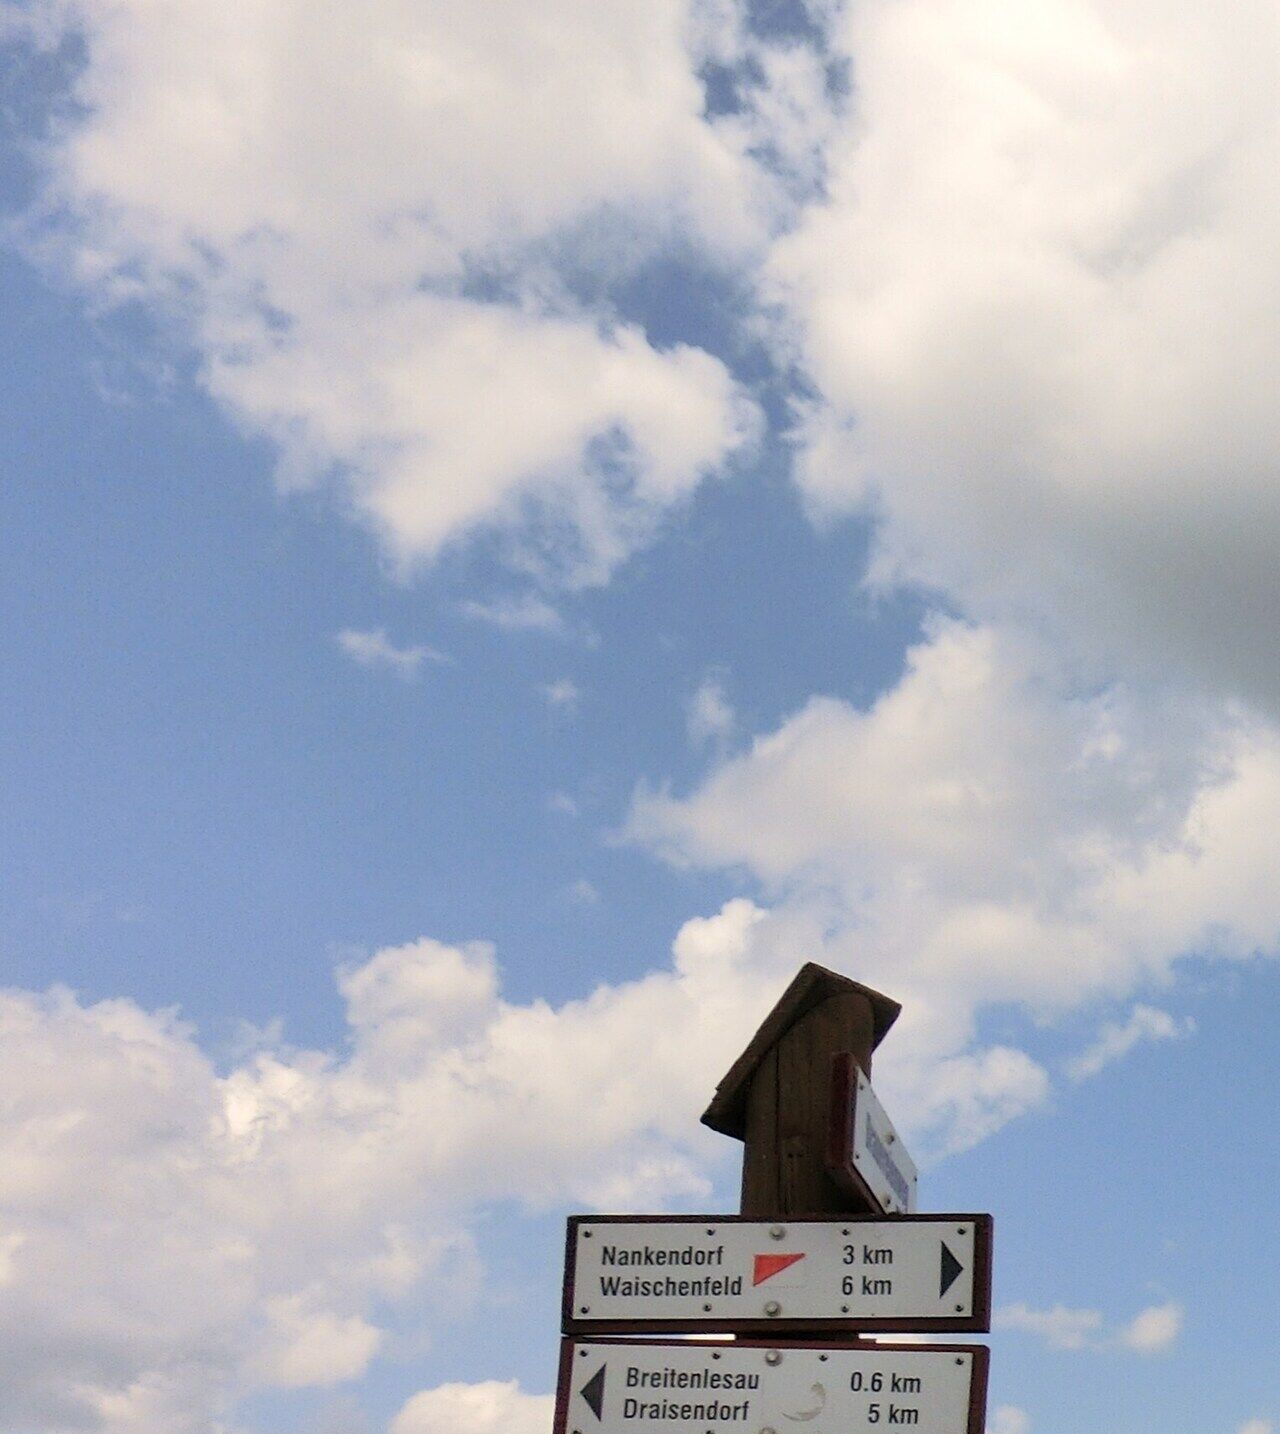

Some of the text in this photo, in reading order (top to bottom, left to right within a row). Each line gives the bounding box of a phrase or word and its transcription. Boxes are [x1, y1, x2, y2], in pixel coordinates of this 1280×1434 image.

[601, 1244, 894, 1267] Nankendorf 3 km
[599, 1275, 892, 1297] Waischenfeld 6 km
[626, 1366, 922, 1394] Breitenlesau 0.6 km
[623, 1398, 919, 1425] Draisendorf 5 km
